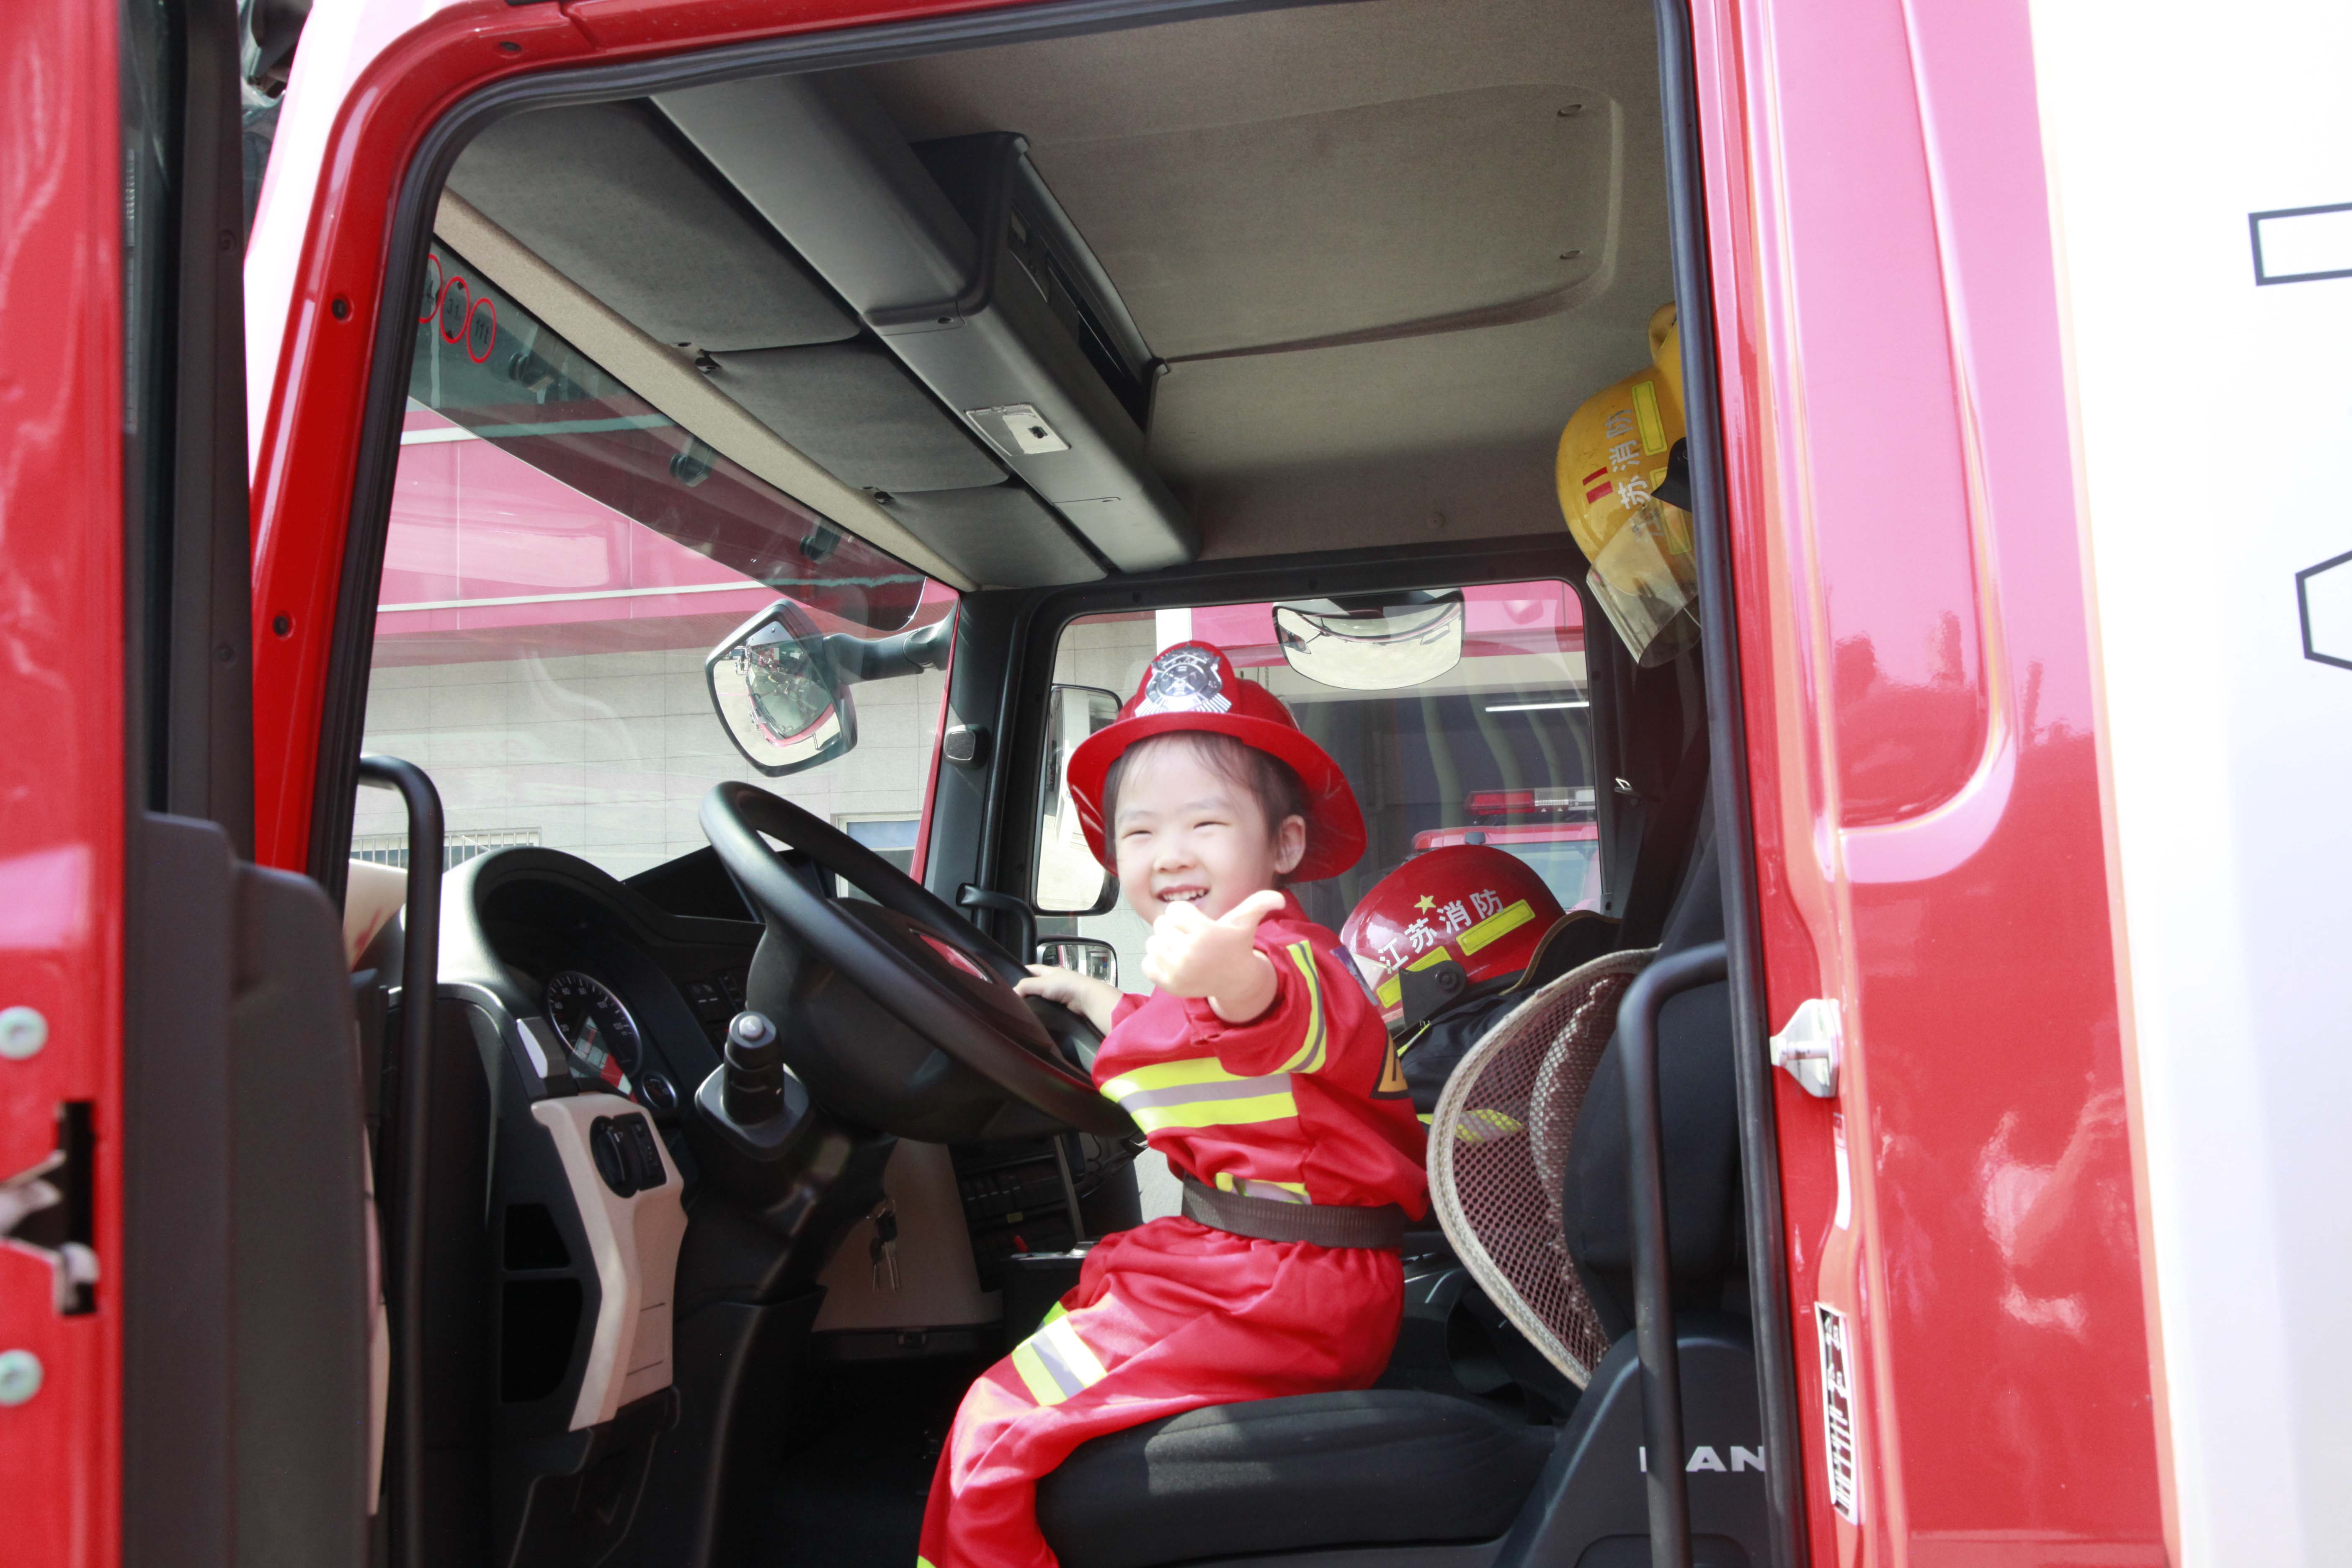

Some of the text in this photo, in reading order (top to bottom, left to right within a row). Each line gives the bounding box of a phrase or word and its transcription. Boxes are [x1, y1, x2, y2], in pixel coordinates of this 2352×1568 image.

[1378, 888, 1504, 974] 江苏消防
[1638, 1446, 1766, 1472] AN
